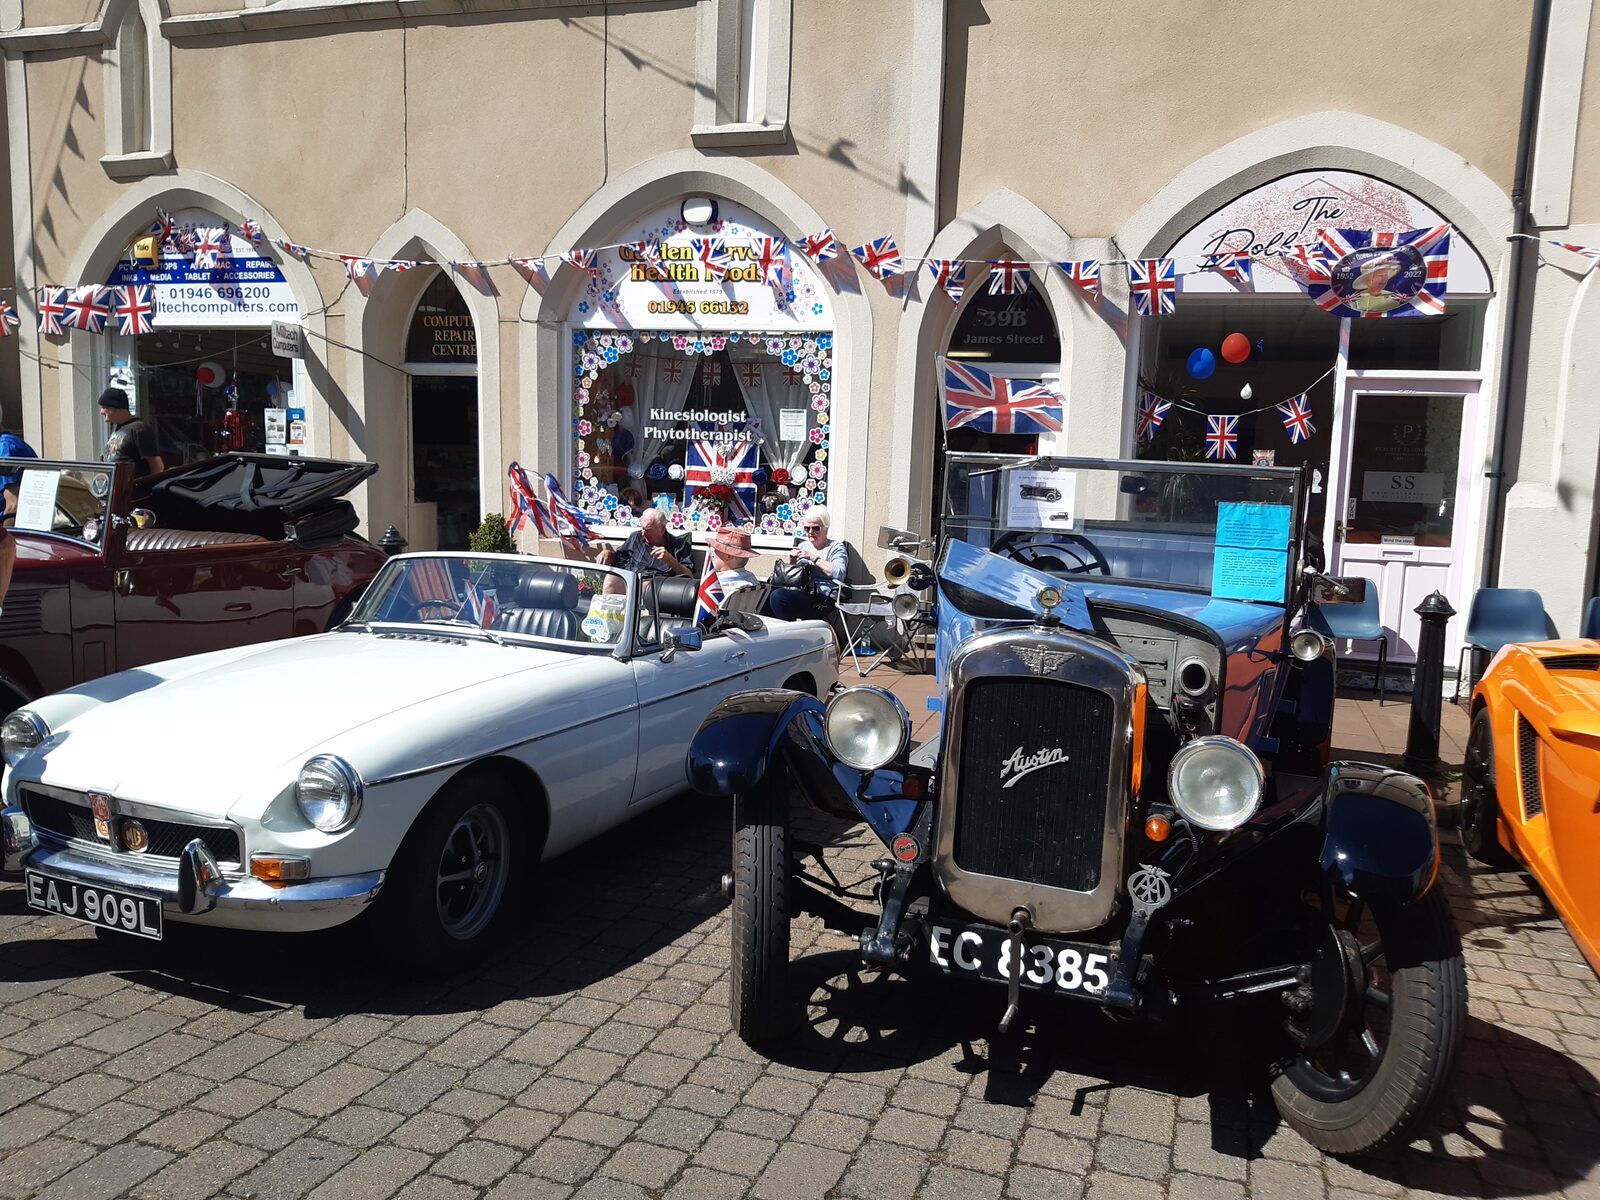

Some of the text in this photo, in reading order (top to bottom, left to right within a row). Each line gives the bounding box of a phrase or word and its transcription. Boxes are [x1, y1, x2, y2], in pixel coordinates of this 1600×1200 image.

[1292, 196, 1346, 234] The
[618, 242, 693, 262] Goen
[214, 261, 231, 269] MAC
[630, 263, 699, 282] Health
[121, 271, 275, 282] INKS MEDIA TABLET ACCESSORIES
[1336, 270, 1422, 280] 1952 2022
[169, 286, 271, 299] 01946 696200
[158, 300, 299, 316] ltechcomputers.com
[647, 300, 749, 315] 01946 66132
[423, 314, 475, 327] COMPUT
[982, 310, 1028, 327] 39B
[434, 329, 475, 342] REPAIR
[963, 333, 1045, 344] James Street
[431, 343, 478, 356] CENTRE
[650, 408, 747, 426] Kinesiologist
[643, 426, 753, 444] Phytotherapist
[1000, 746, 1069, 788] Austin
[29, 874, 159, 936] EAJ 909L
[930, 925, 1110, 994] EC 8385
